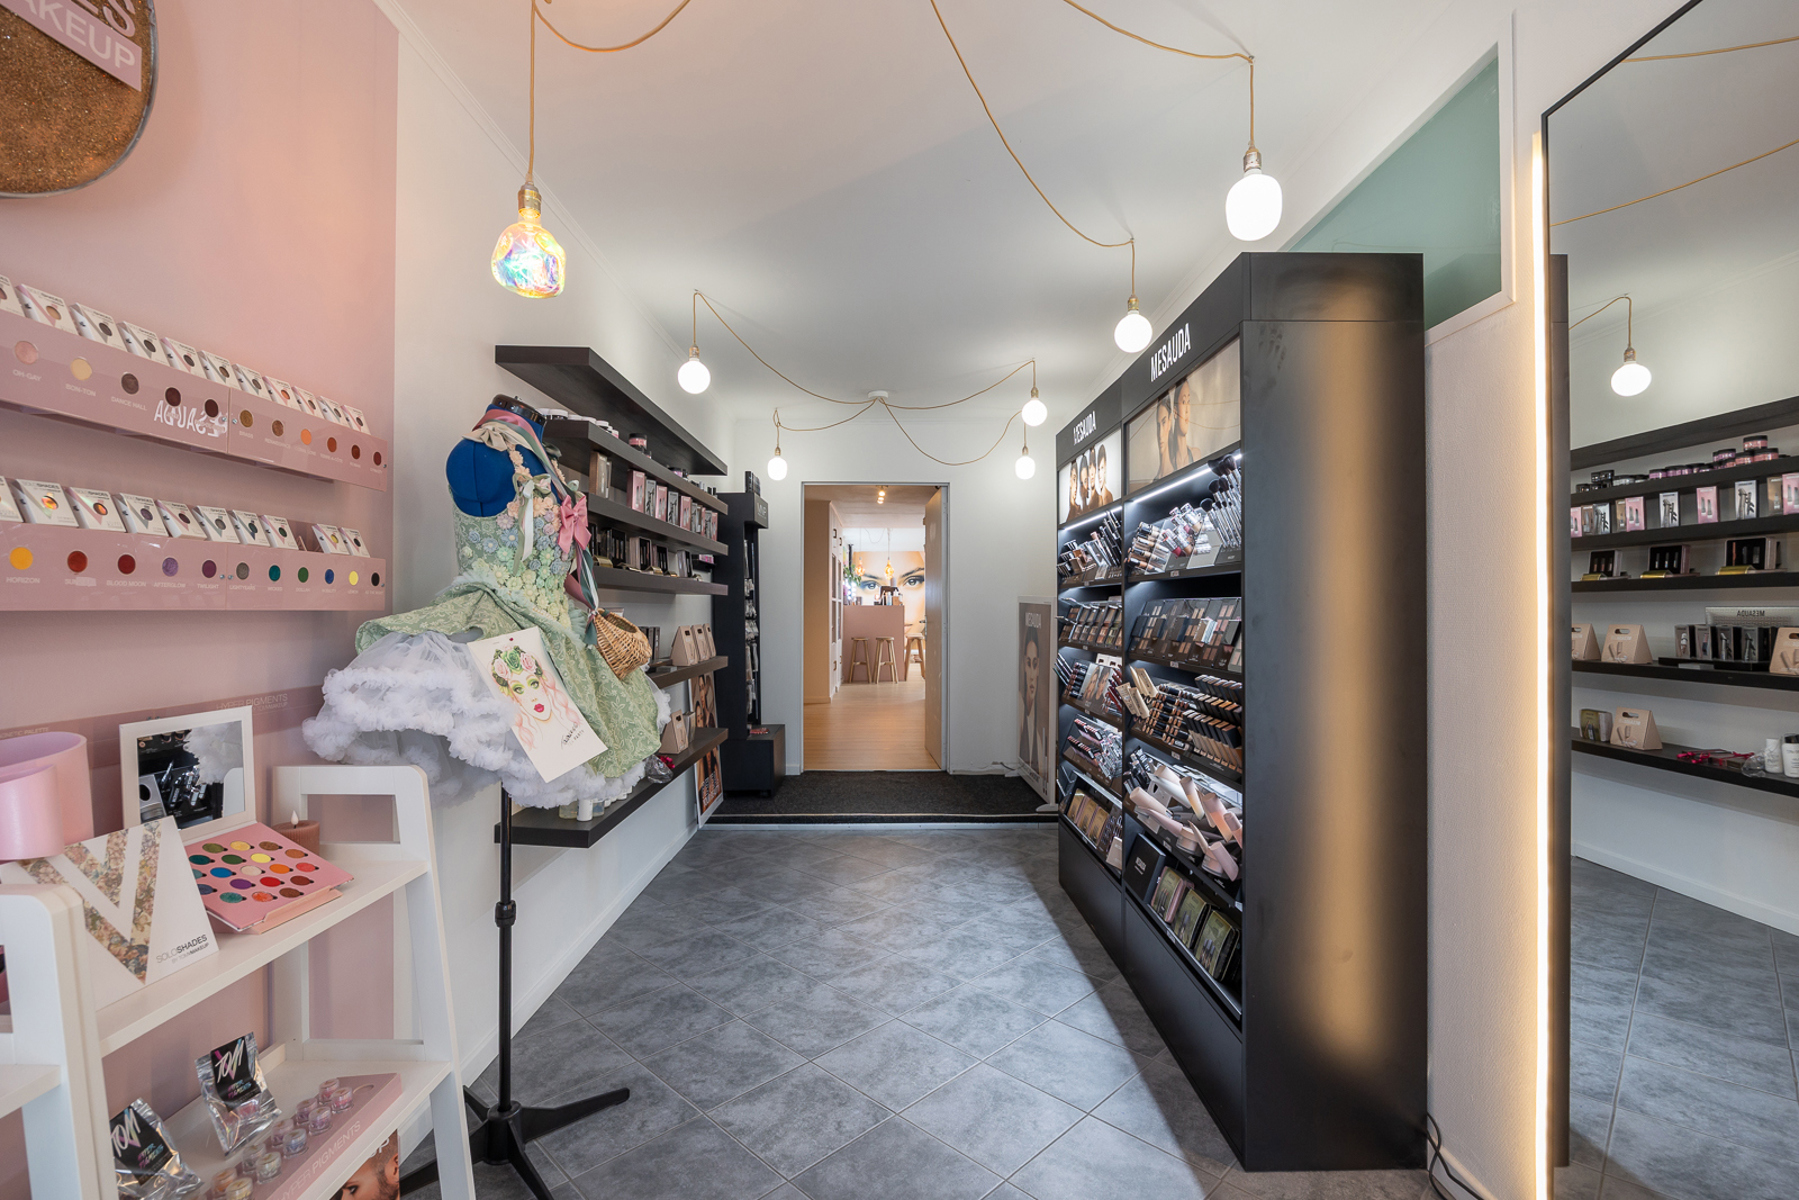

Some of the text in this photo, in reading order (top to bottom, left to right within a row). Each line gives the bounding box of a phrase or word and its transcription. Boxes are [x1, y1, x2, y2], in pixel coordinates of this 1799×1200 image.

[1150, 322, 1192, 383] MESAUDA
[6, 576, 40, 584] HORIZON
[128, 580, 147, 588] MOON
[246, 693, 288, 706] PIGMENTS
[156, 933, 208, 963] SOLOSHADES
[312, 1120, 362, 1174] PIGMENTS
